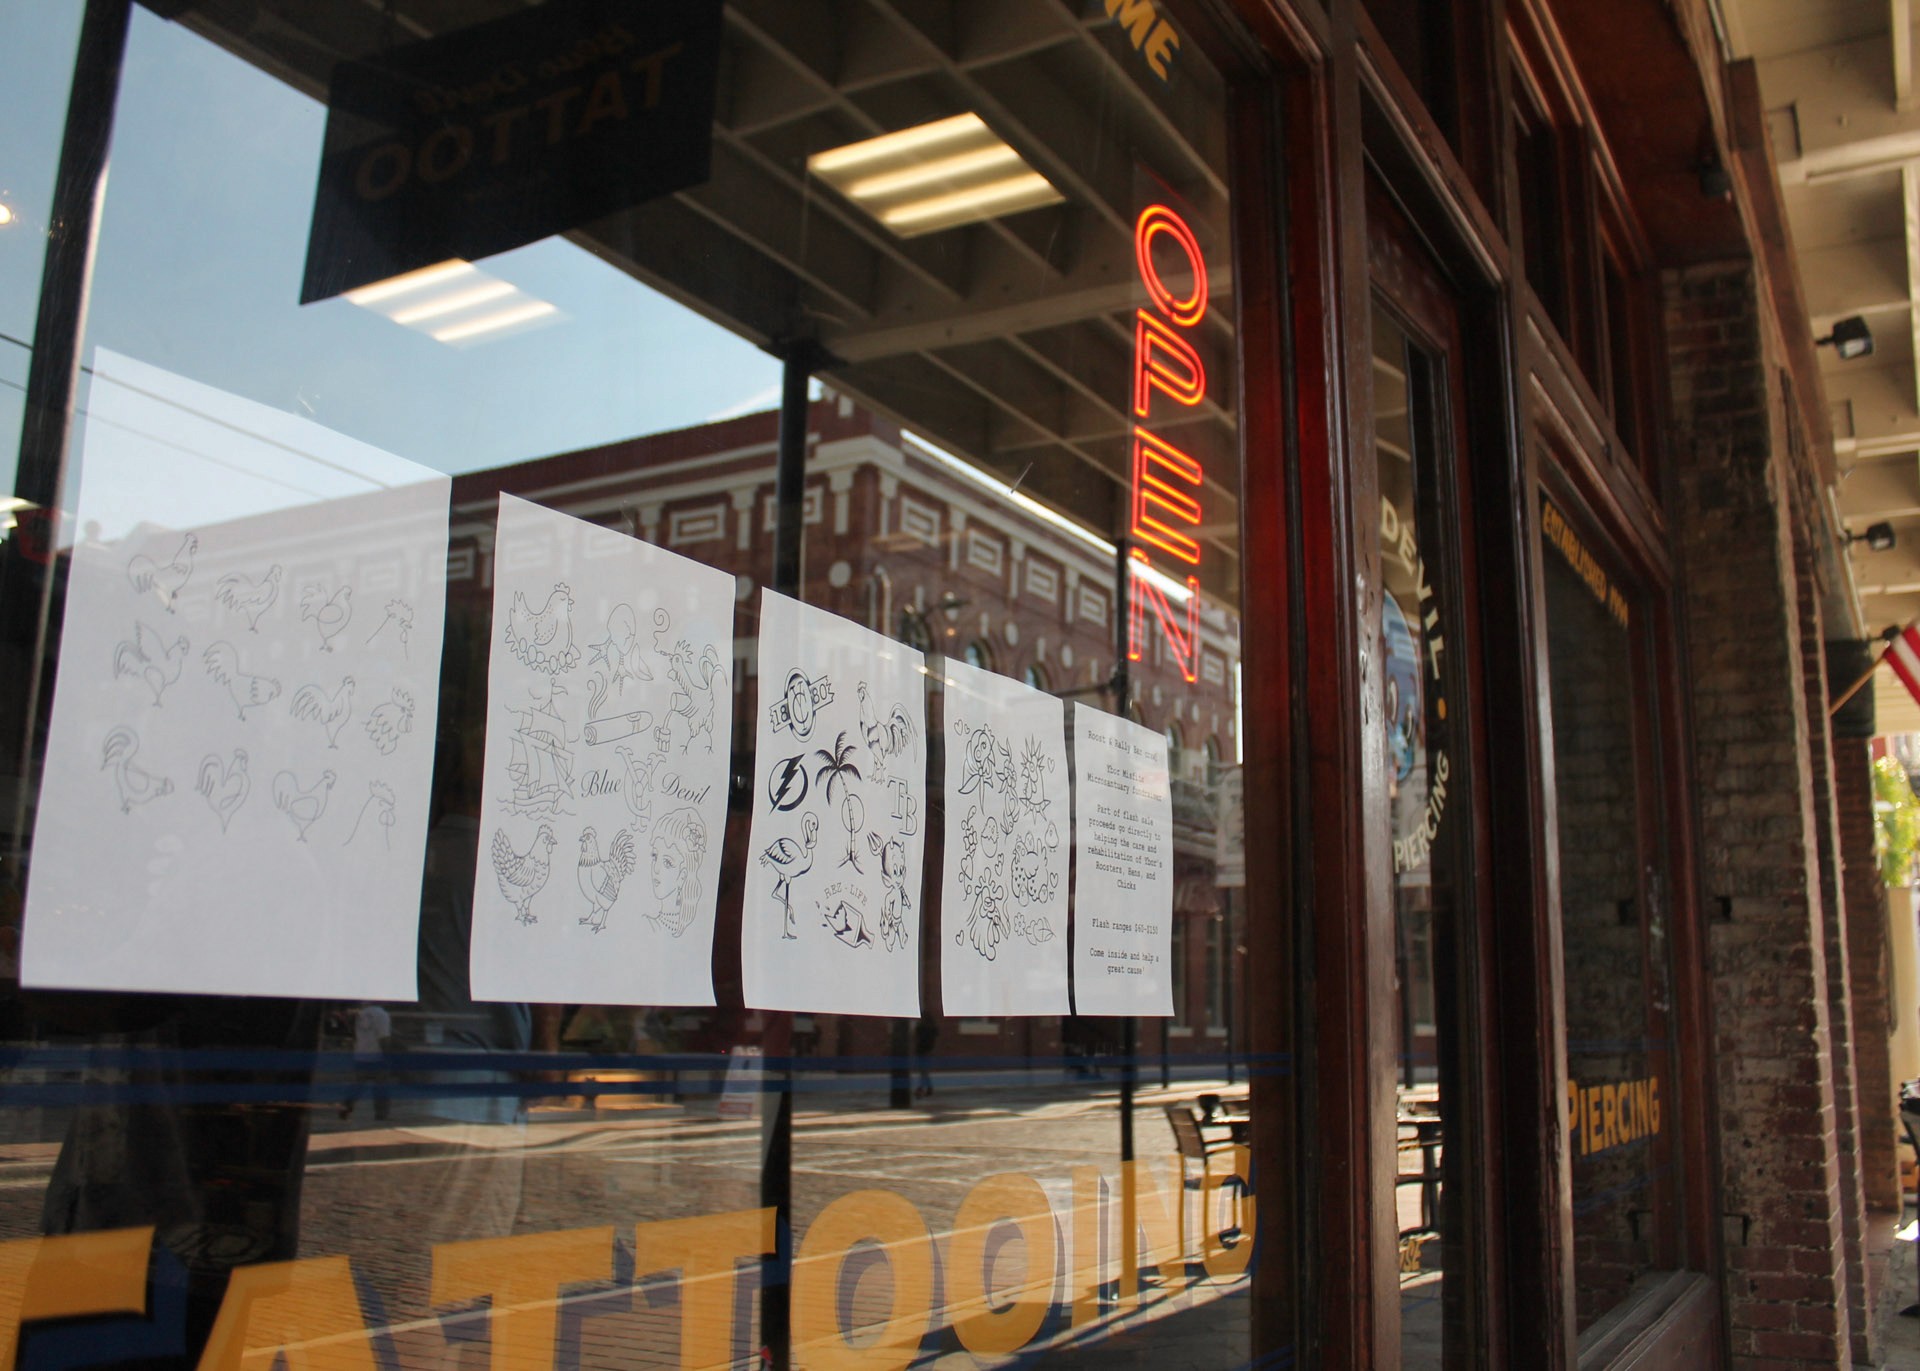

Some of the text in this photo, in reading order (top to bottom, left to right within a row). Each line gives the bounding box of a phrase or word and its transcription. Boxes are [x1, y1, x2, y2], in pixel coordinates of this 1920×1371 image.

[1127, 203, 1208, 683] OPEN
[1381, 495, 1444, 680] DEVIL
[773, 704, 788, 727] 18
[811, 682, 827, 705] 80
[581, 768, 622, 798] Blue
[660, 772, 711, 804] Devil
[1097, 804, 1111, 816] Part
[1114, 809, 1121, 818] of
[1123, 811, 1139, 822] flash
[1394, 749, 1449, 873] PIERCING
[1088, 818, 1161, 841] proceeds go directly to
[1094, 831, 1157, 854] helping the care and
[1087, 845, 1133, 862] rehabilitation
[1135, 855, 1142, 865] of
[1117, 879, 1136, 891] Chicks
[1146, 871, 1156, 881] and
[1092, 918, 1109, 929] Flash
[1112, 922, 1132, 934] ranges
[1089, 947, 1104, 958] Come
[1107, 949, 1128, 960] inside
[1130, 951, 1140, 961] and
[1141, 952, 1154, 965] help
[1107, 965, 1125, 975] great
[1568, 1077, 1660, 1156] PIERCING
